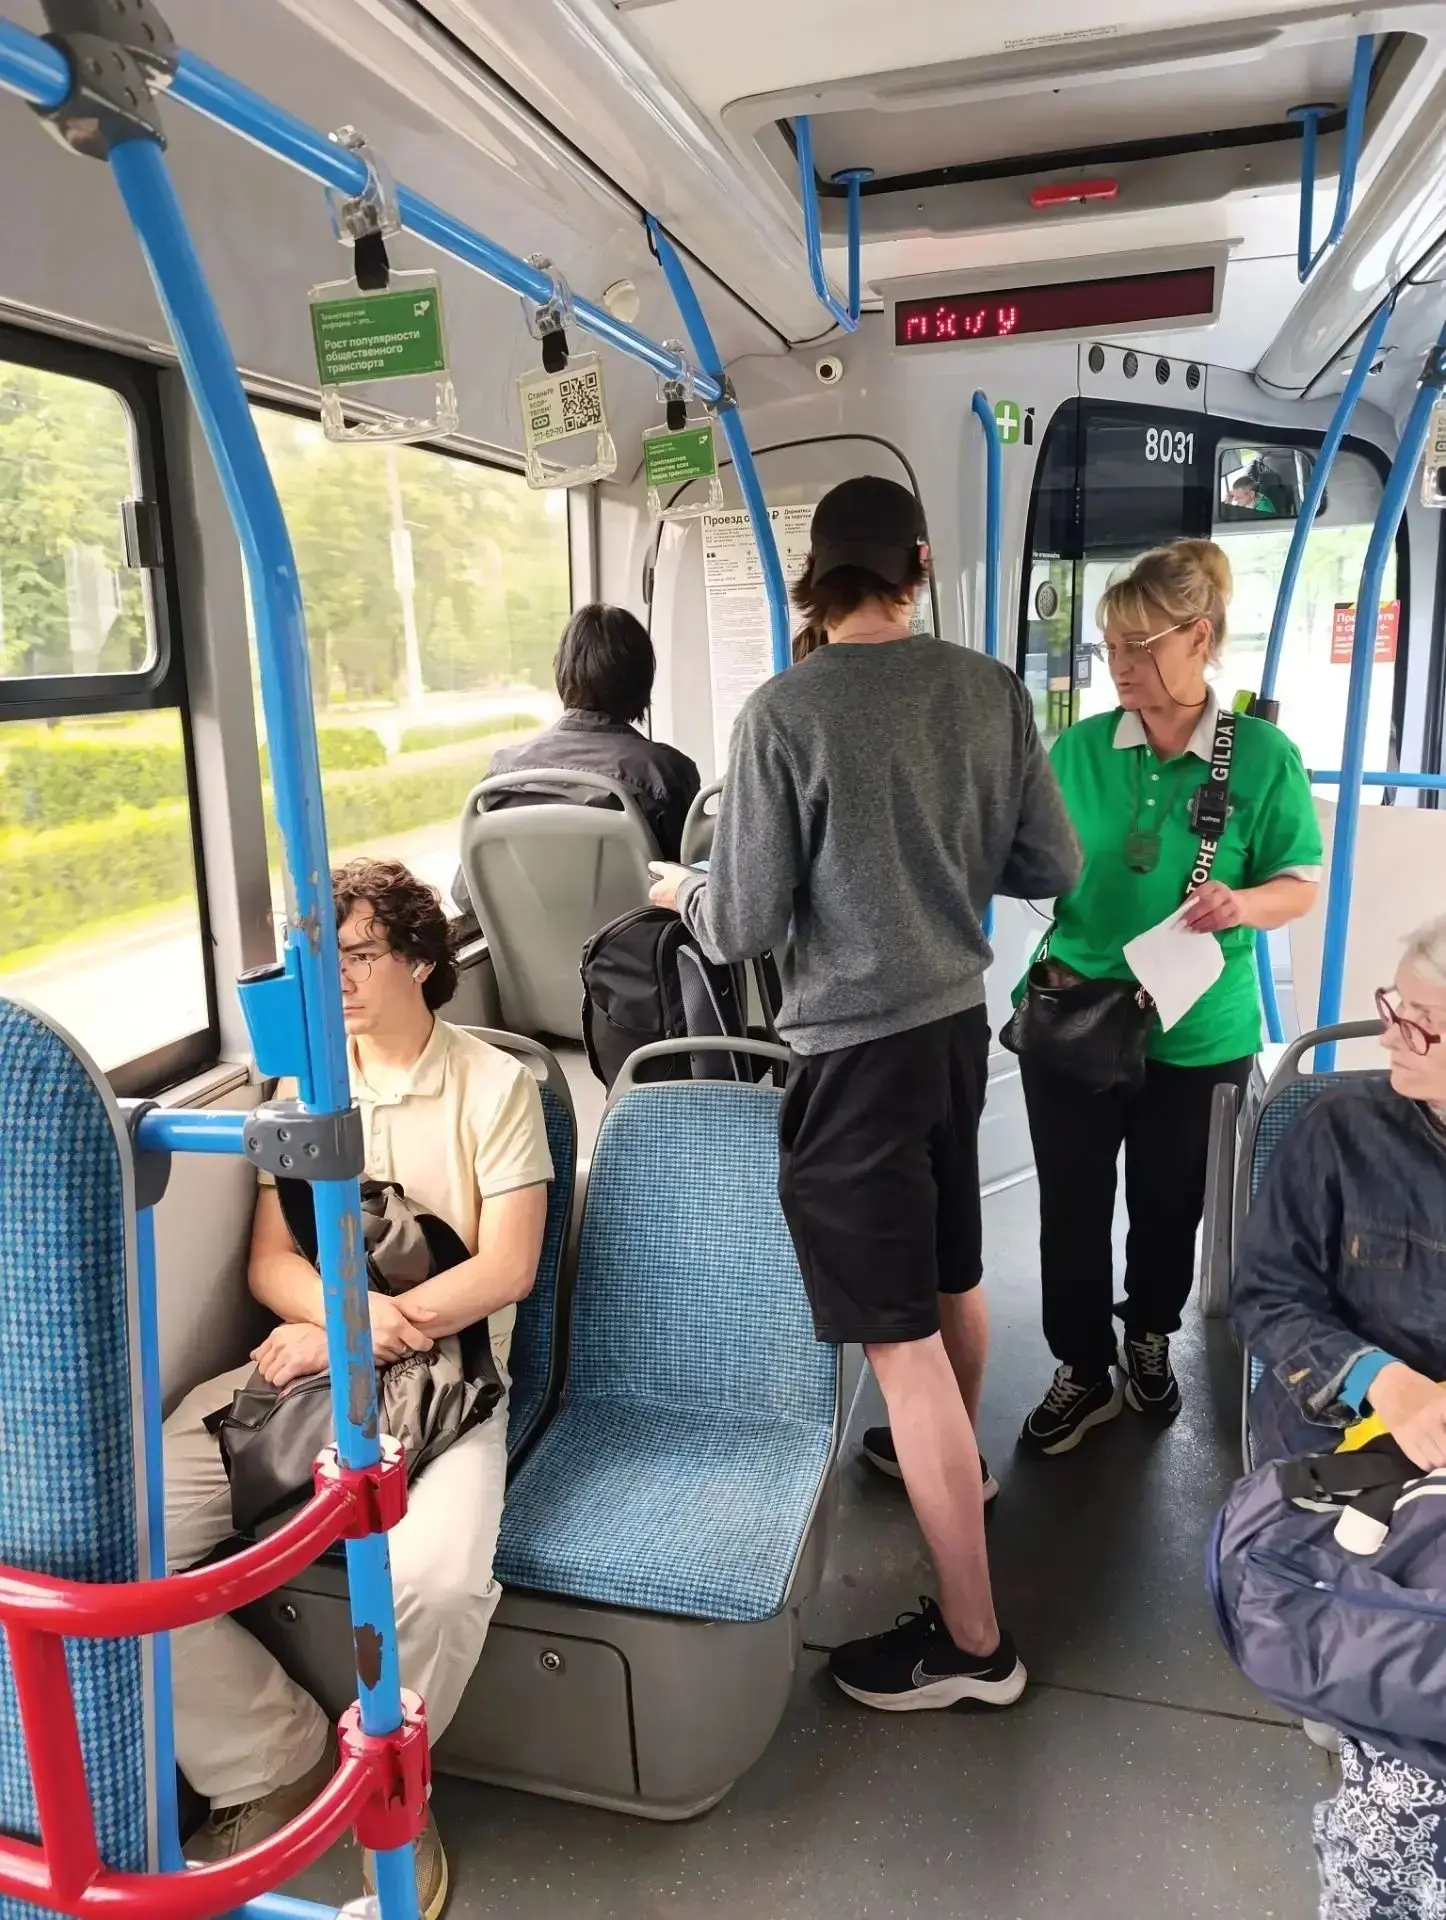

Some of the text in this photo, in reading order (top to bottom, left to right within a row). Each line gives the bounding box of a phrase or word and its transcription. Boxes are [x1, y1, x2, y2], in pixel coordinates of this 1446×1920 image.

[324, 330, 420, 350] Рост популярности
[326, 345, 403, 362] общественного
[327, 359, 384, 375] транспорта
[527, 388, 554, 401] Станьте
[1145, 427, 1194, 465] 8031
[703, 515, 743, 527] Проезд
[1211, 725, 1235, 781] GILDA
[1186, 836, 1217, 894] TOHE
